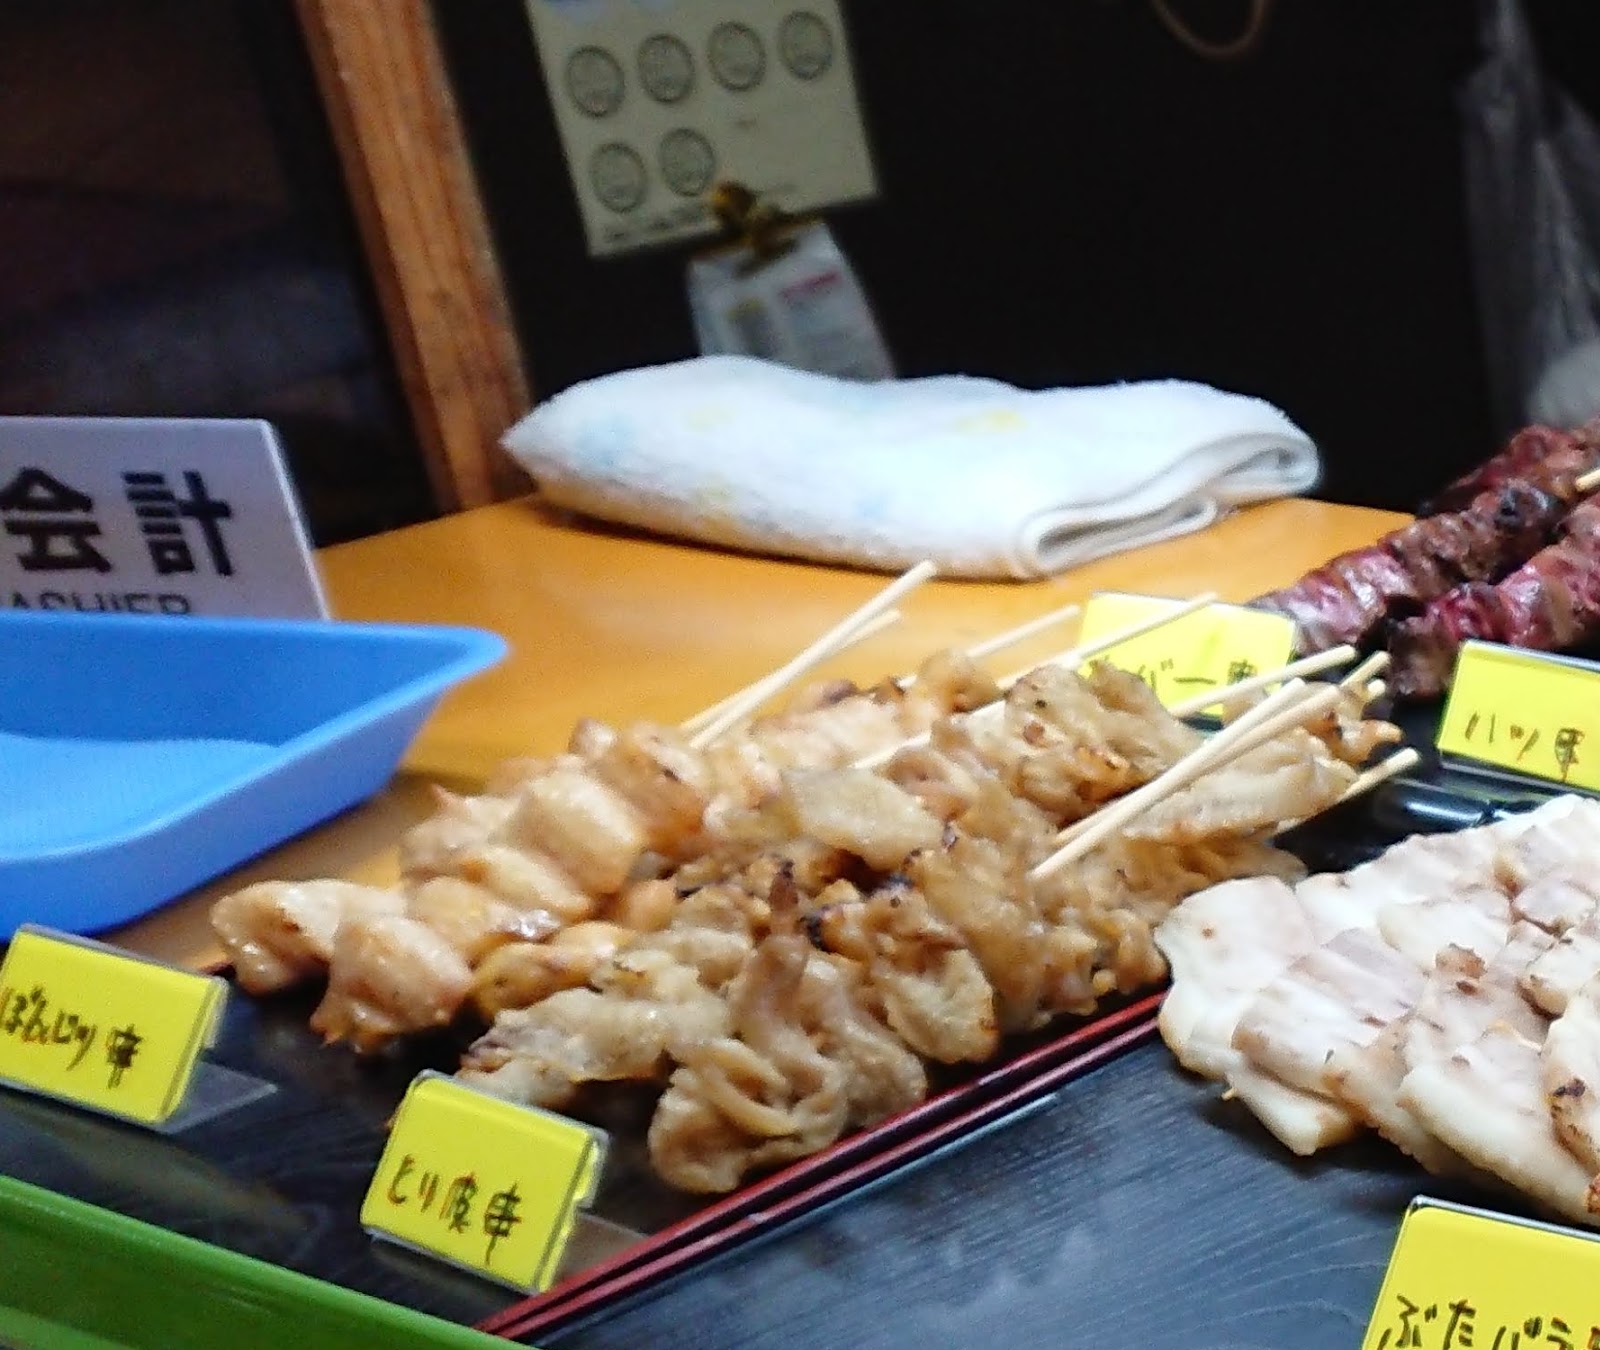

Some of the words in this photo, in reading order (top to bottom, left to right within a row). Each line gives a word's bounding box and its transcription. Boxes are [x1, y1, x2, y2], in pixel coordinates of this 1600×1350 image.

[0, 466, 235, 576] 会計
[386, 1153, 523, 1265] とり皮串
